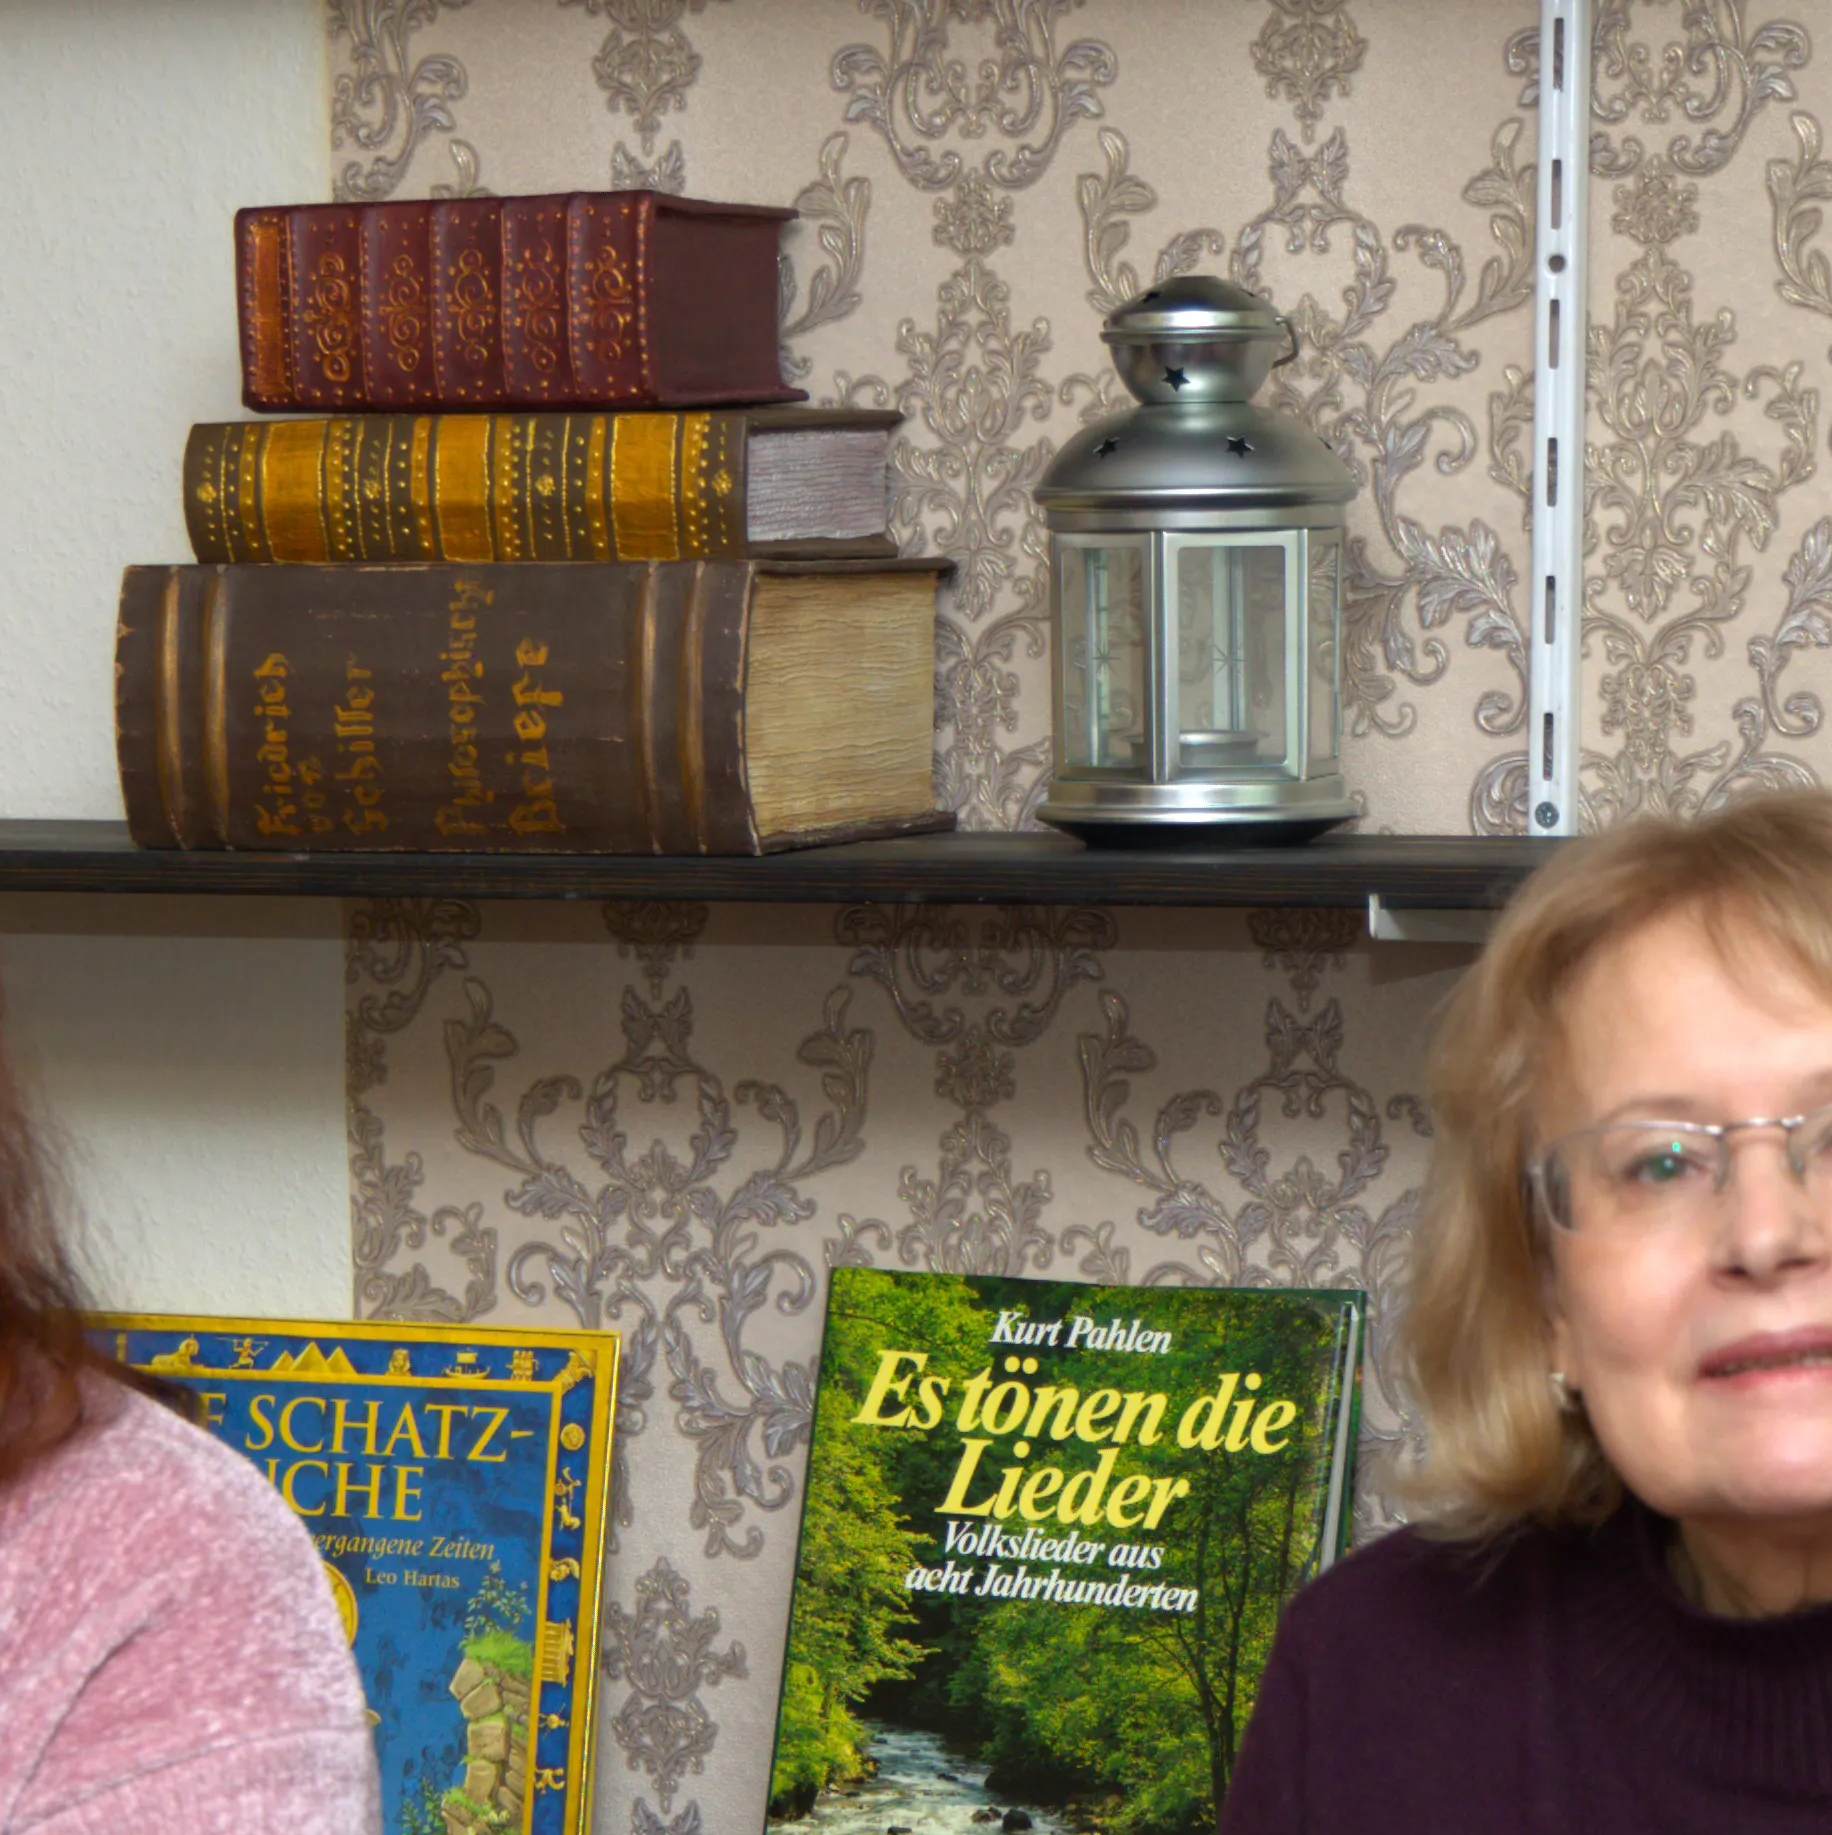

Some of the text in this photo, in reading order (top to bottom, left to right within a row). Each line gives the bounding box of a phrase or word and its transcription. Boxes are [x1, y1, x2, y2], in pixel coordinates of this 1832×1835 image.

[989, 1310, 1173, 1355] Kurt Pahlen
[850, 1349, 1297, 1455] Es tönen die
[245, 1394, 535, 1463] SCHATZ-
[934, 1437, 1192, 1531] Lieder
[428, 1536, 496, 1561] Zeiten
[944, 1520, 1165, 1570] Volkslieder aus
[365, 1567, 461, 1589] Leo Hartas
[904, 1563, 1200, 1613] acht Jahrhunderten
